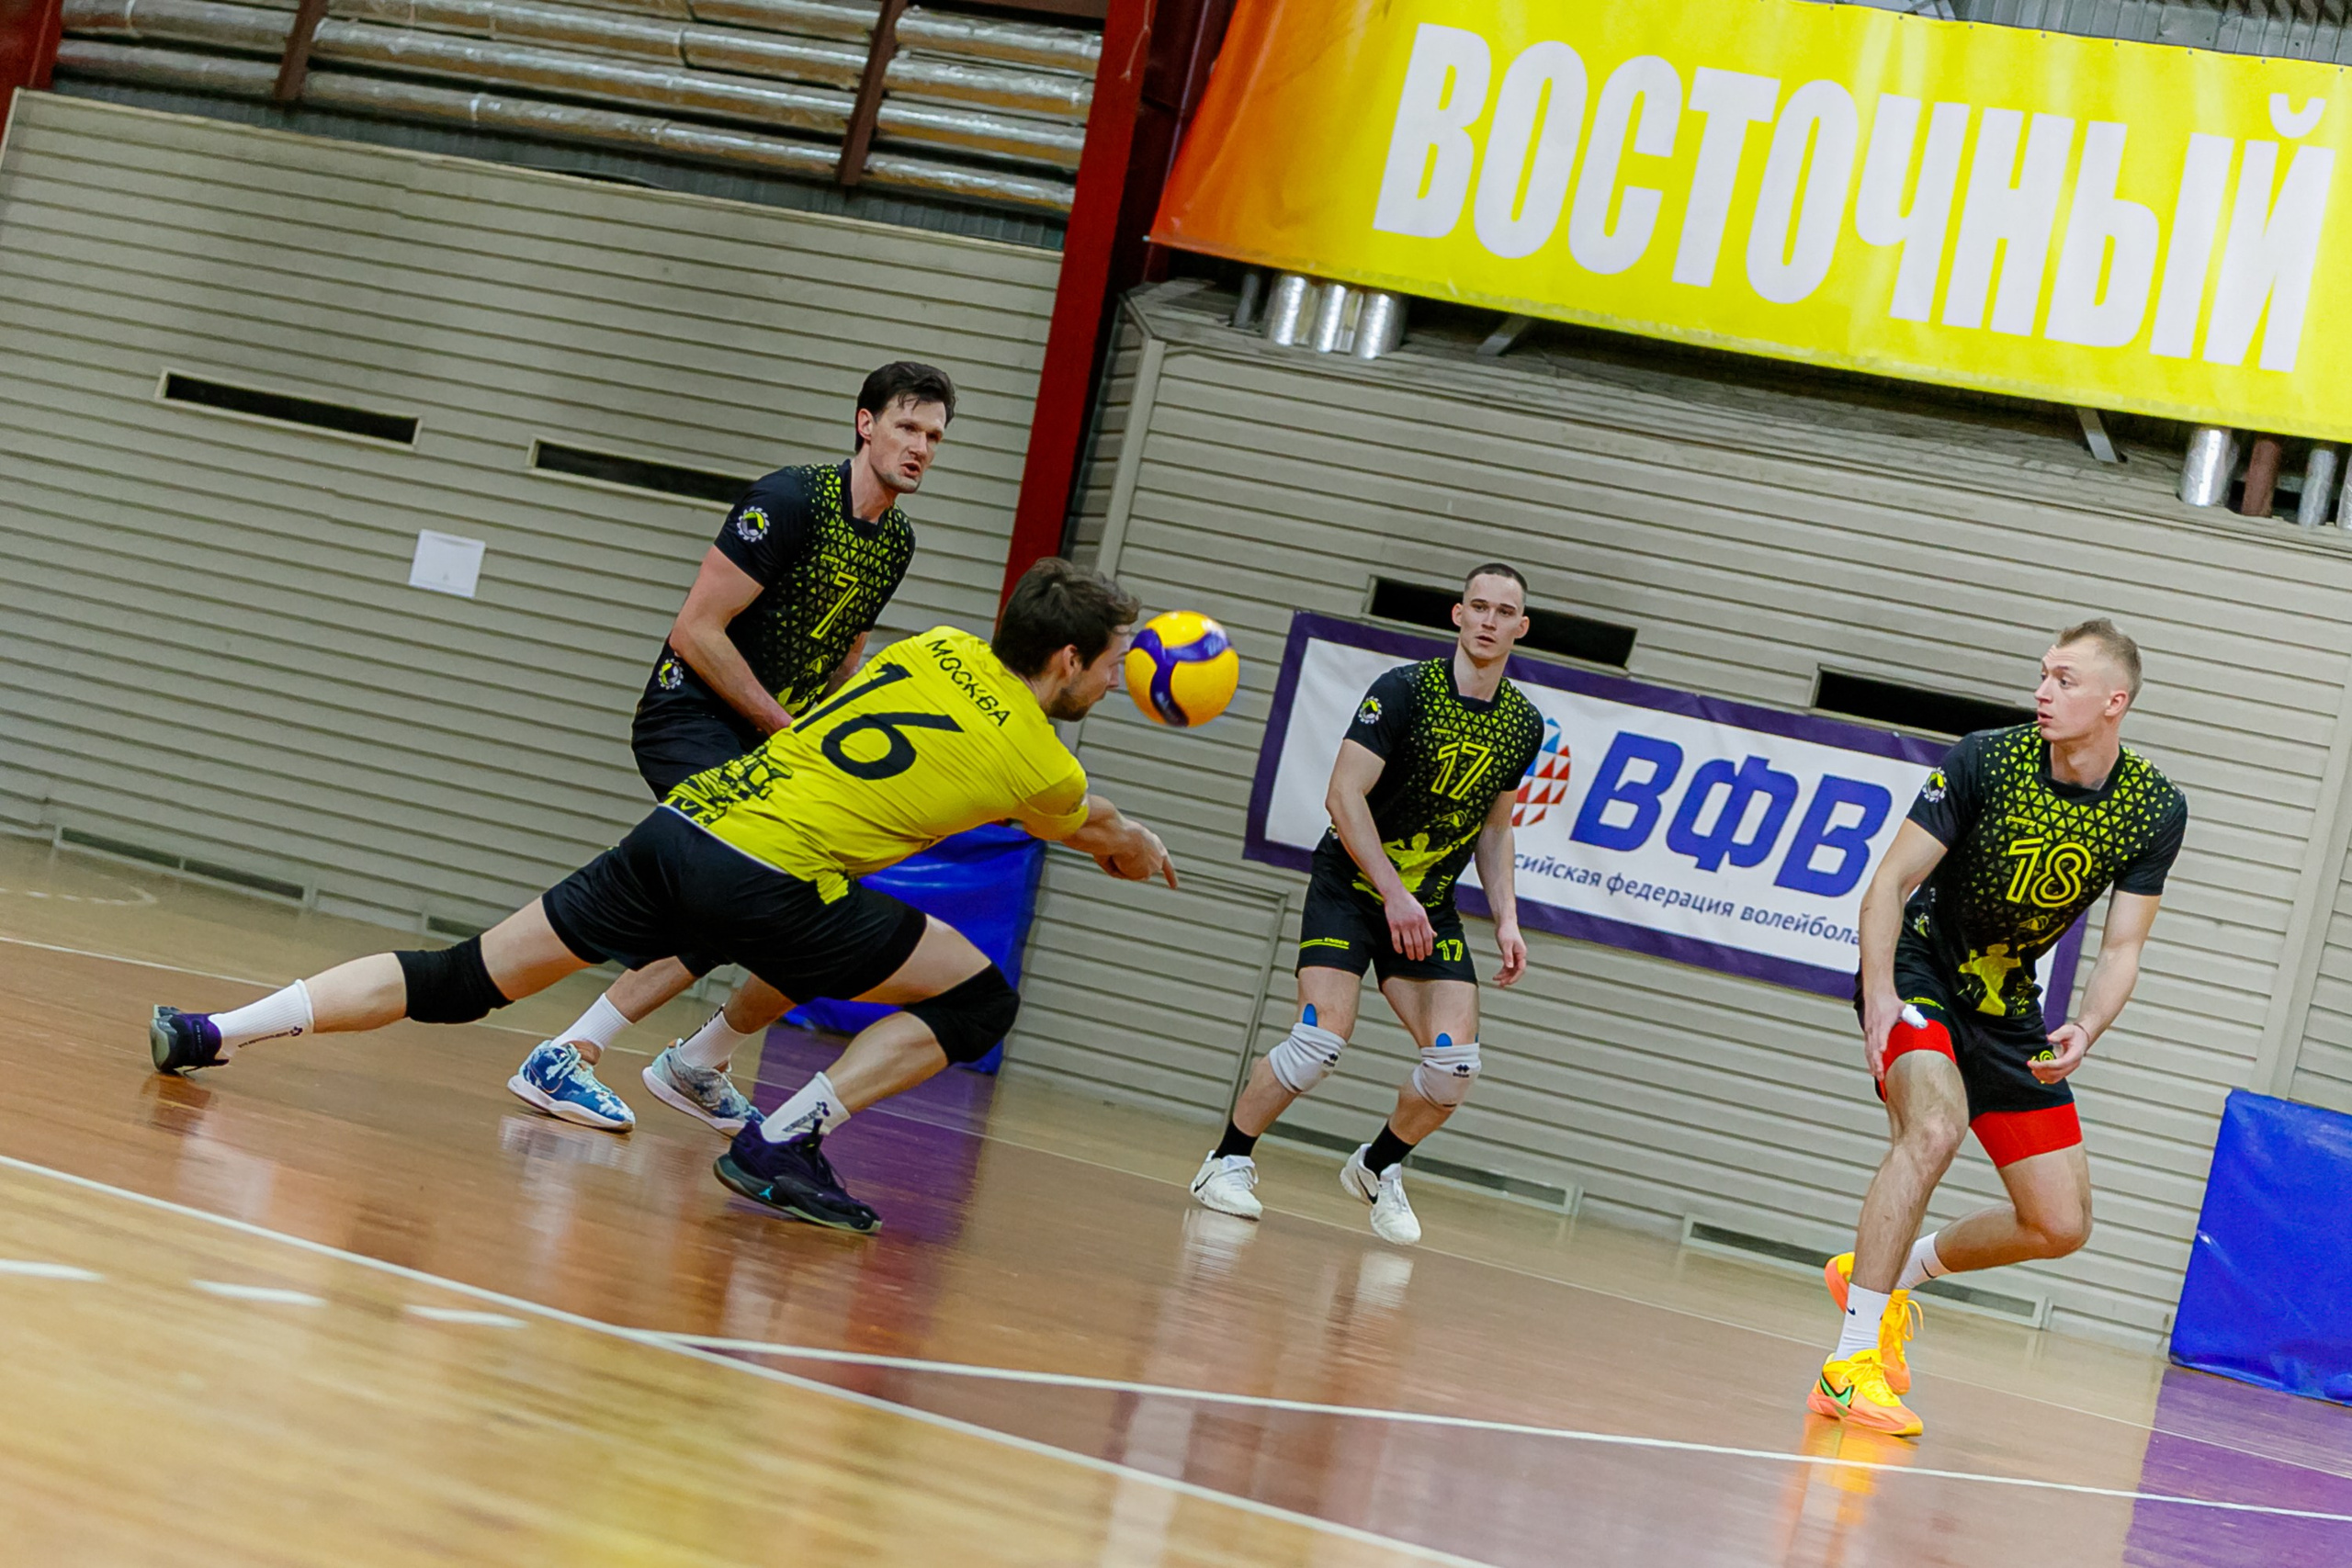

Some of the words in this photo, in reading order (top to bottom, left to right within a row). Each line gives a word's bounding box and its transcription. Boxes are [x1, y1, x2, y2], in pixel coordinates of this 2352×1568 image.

[1373, 23, 2335, 373] ВОСТОЧНЫЙ
[810, 570, 859, 639] 7
[925, 639, 1011, 727] МОСКВА
[793, 661, 965, 780] 16
[1430, 740, 1494, 801] 17
[1569, 731, 1893, 898] ВФВ
[1606, 872, 1735, 918] федерация
[2006, 837, 2093, 908] 18
[1436, 939, 1464, 962] 17
